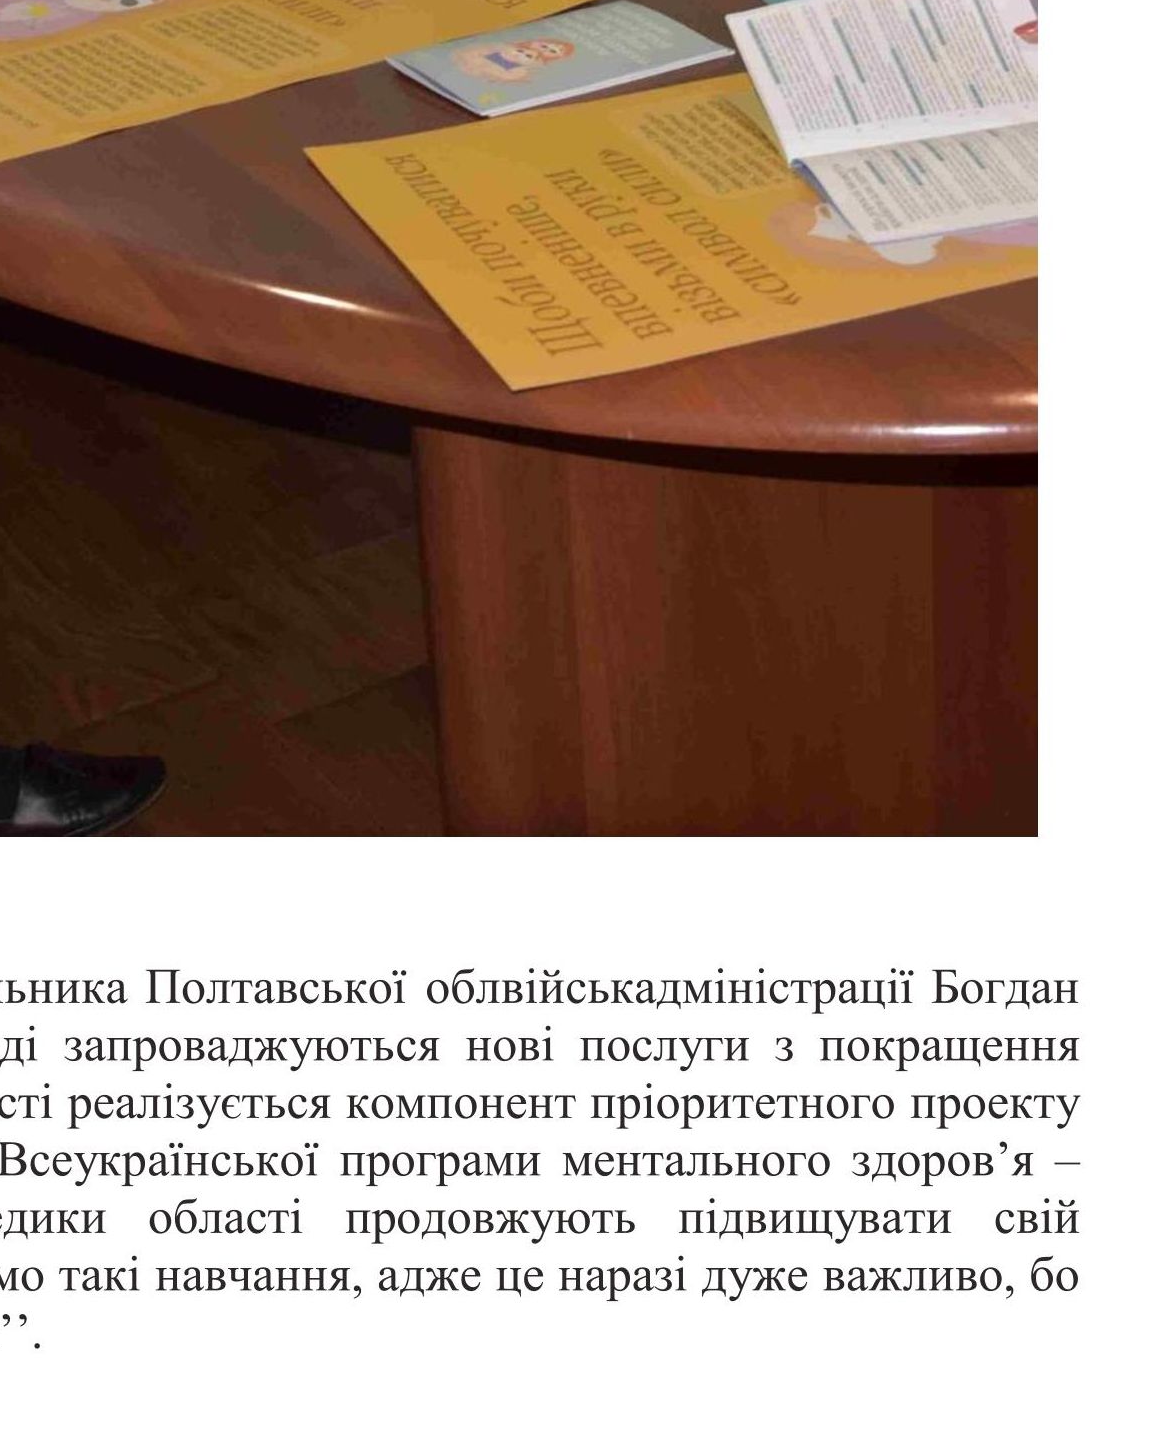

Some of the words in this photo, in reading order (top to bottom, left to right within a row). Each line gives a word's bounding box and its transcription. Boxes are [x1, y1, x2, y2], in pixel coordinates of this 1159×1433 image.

[385, 153, 524, 272] почуватися
[544, 169, 639, 221] руки
[598, 149, 682, 206] сили»
[507, 194, 674, 340] впевненіше,
[605, 221, 644, 238] в
[665, 209, 803, 306] «символ
[494, 274, 604, 356] Щоби
[624, 239, 741, 324] візьми
